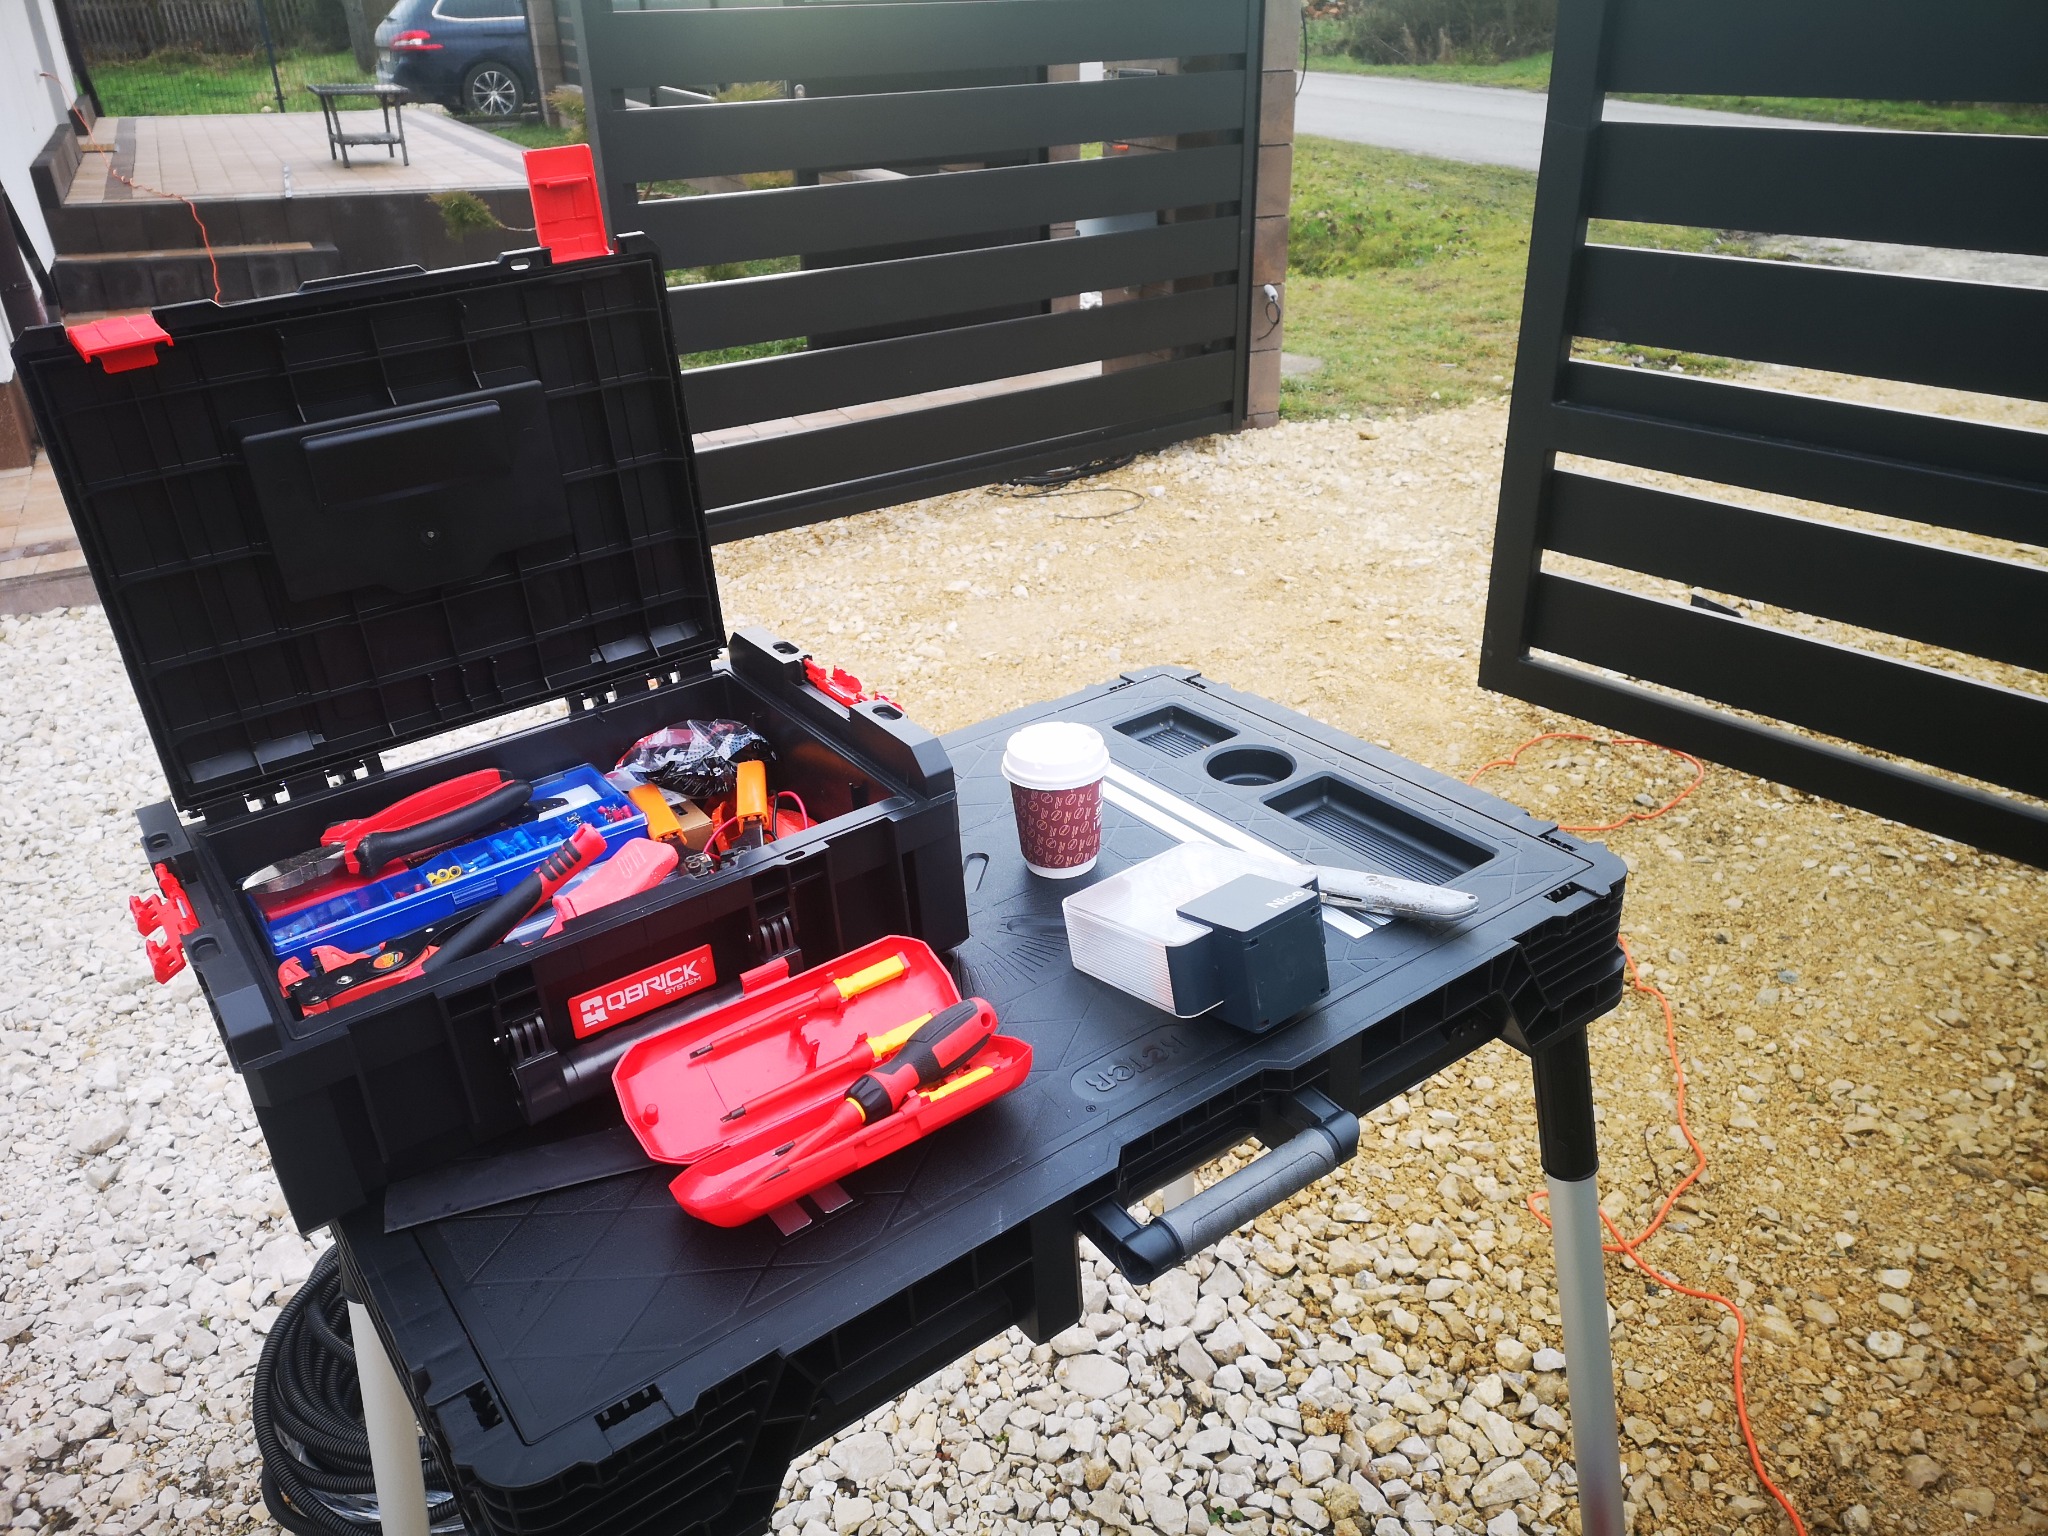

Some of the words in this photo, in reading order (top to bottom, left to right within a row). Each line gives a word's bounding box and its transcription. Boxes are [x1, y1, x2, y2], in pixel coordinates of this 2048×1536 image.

[1265, 890, 1305, 909] Nice
[605, 959, 700, 1012] QBRICK
[664, 975, 702, 996] SYSTEM
